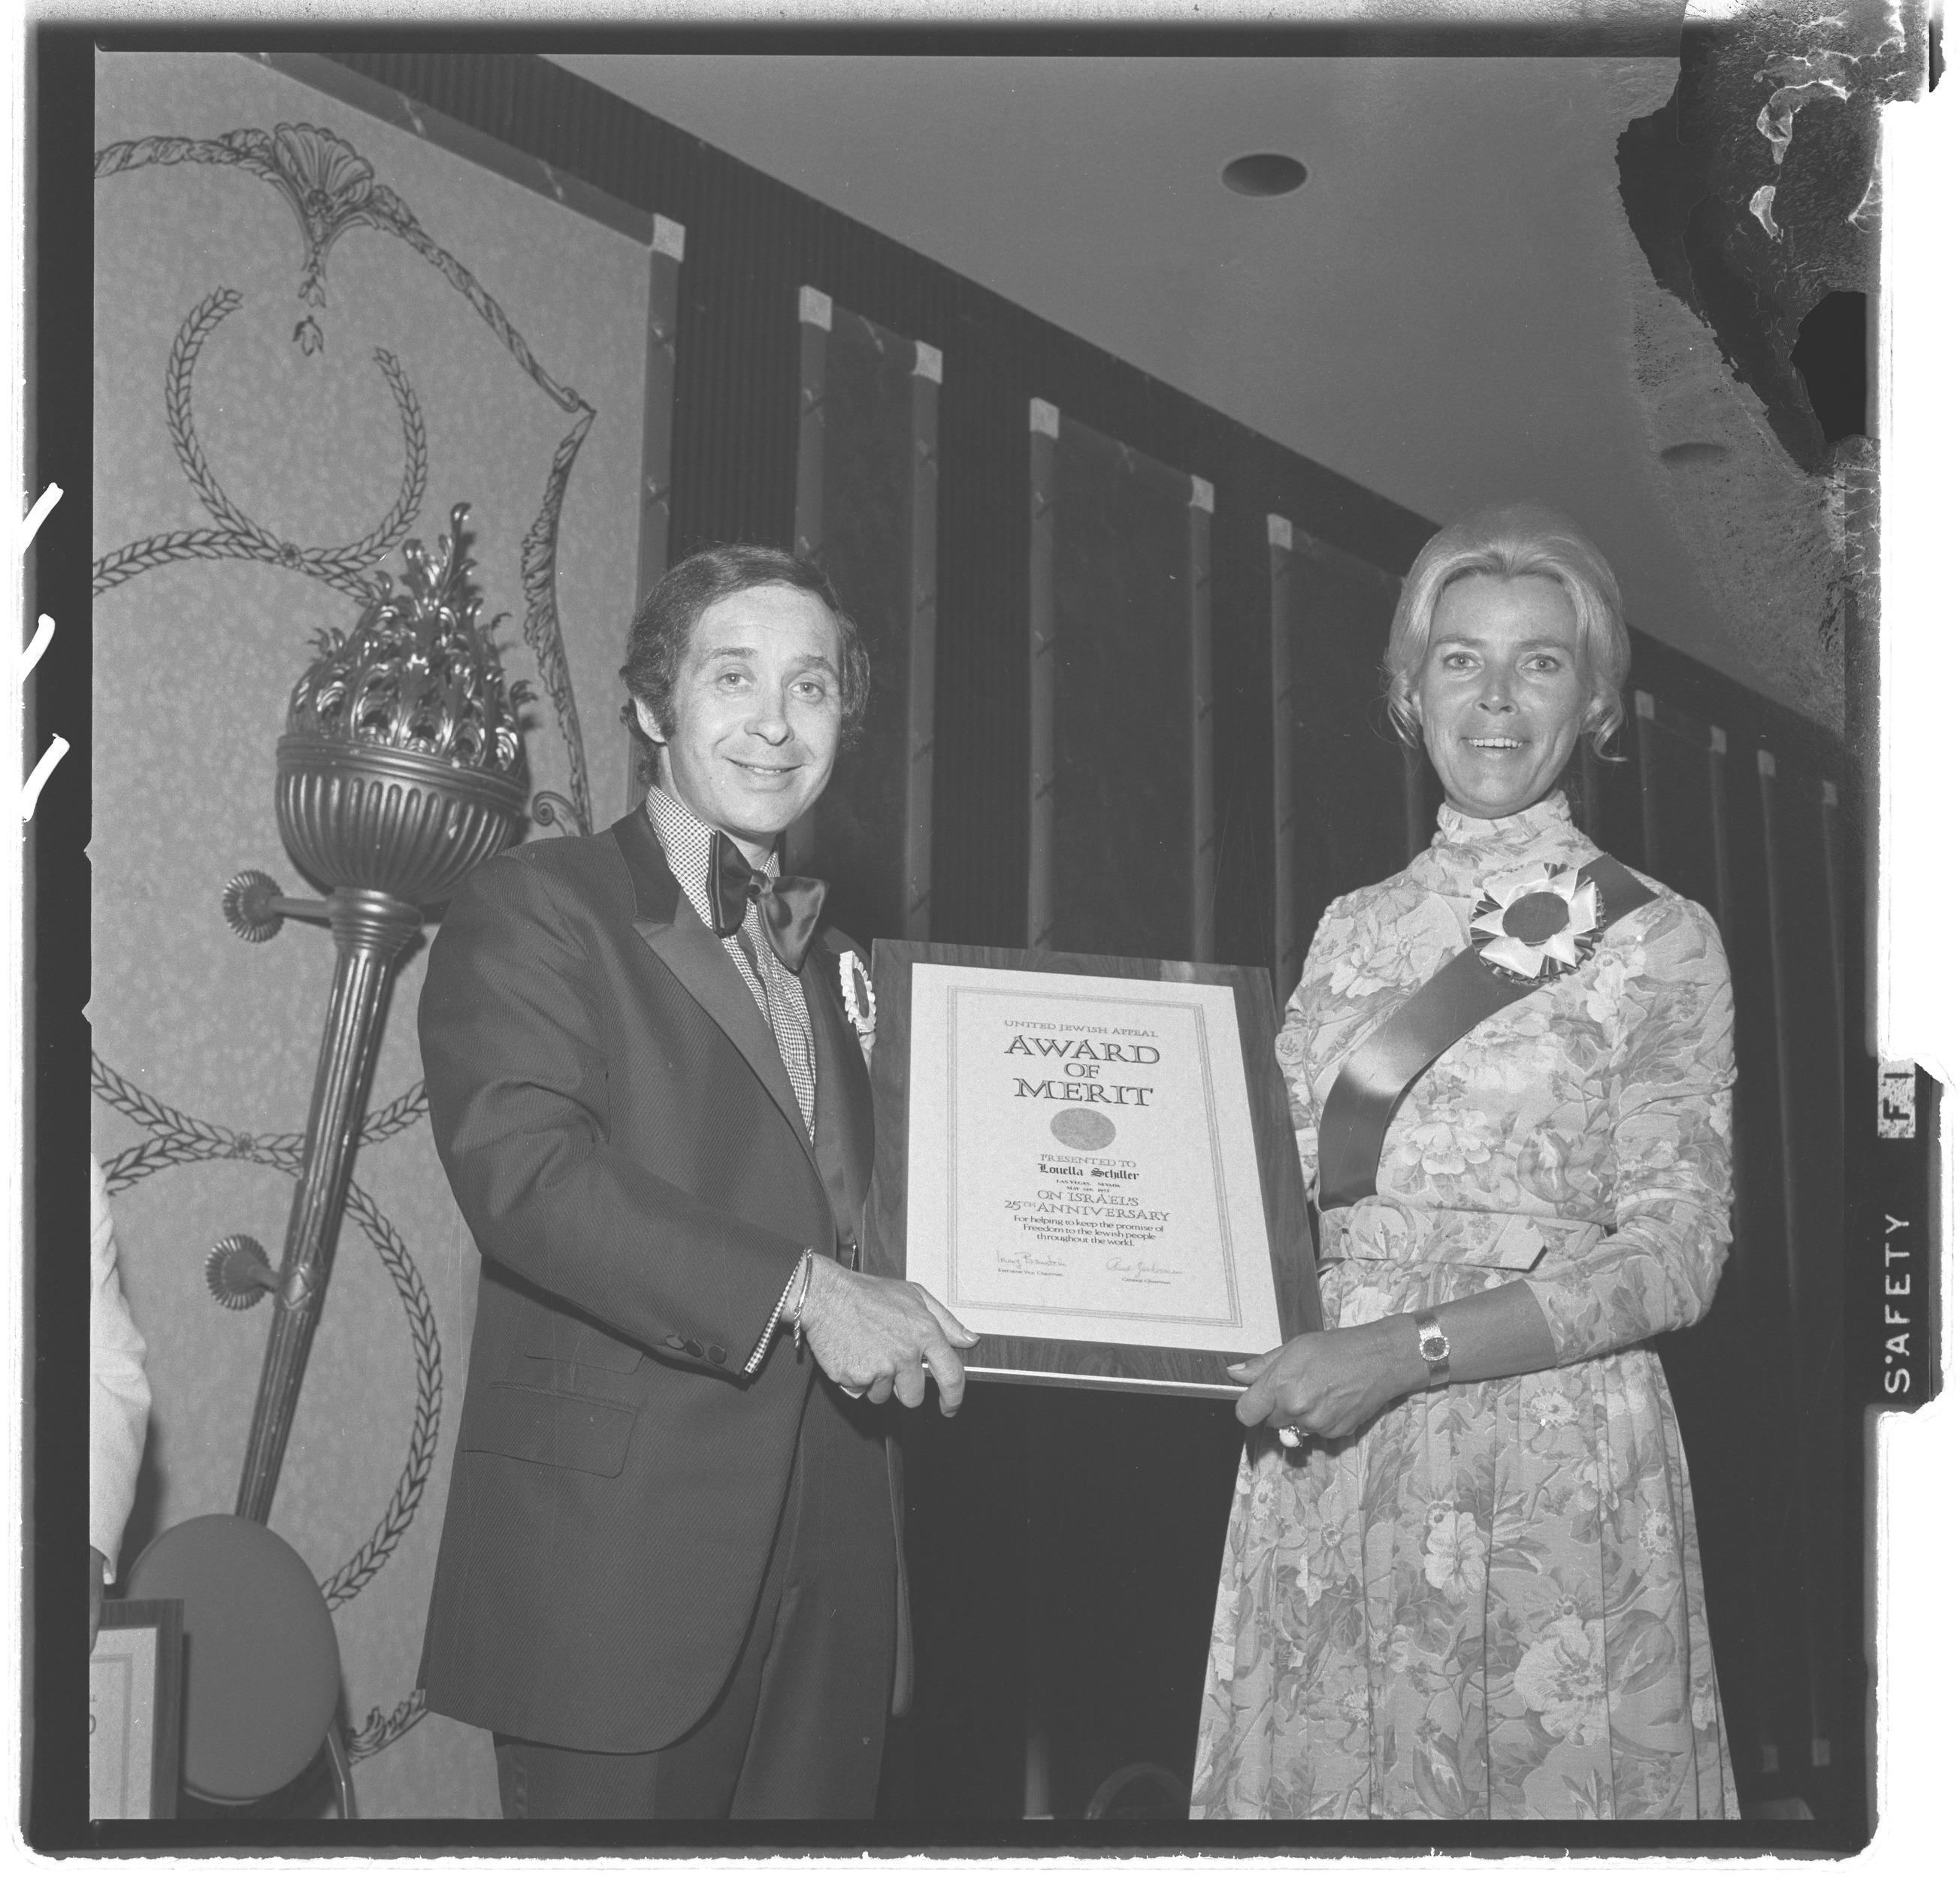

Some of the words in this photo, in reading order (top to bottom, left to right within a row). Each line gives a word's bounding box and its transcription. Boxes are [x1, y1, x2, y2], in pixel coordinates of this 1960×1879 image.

[1004, 1020, 1056, 1030] UNITED
[1059, 1023, 1107, 1034] JEWISH
[1112, 1027, 1158, 1037] APPEAL
[1004, 1034, 1160, 1064] AWARD
[1063, 1062, 1100, 1079] OF
[1012, 1078, 1154, 1106] MERIT
[1040, 1154, 1117, 1166] PRESENTED
[1118, 1160, 1136, 1168] TO
[1037, 1163, 1084, 1176] Louella
[1090, 1167, 1139, 1180] Schiller
[1037, 1190, 1063, 1201] ON
[1067, 1192, 1139, 1206] ISRAEL'S
[1036, 1203, 1171, 1221] ANNIVERSARY
[1014, 1215, 1030, 1223] For
[1030, 1215, 1063, 1226] helping
[1075, 1219, 1098, 1228] keep
[1115, 1223, 1153, 1232] promise
[1155, 1224, 1164, 1233] of
[1023, 1224, 1064, 1233] Freedom
[1078, 1227, 1092, 1236] the
[1094, 1230, 1124, 1239] Jewish
[1126, 1232, 1157, 1241] people
[1036, 1233, 1089, 1244] throughout
[1090, 1236, 1106, 1245] the
[1107, 1238, 1135, 1247] world.
